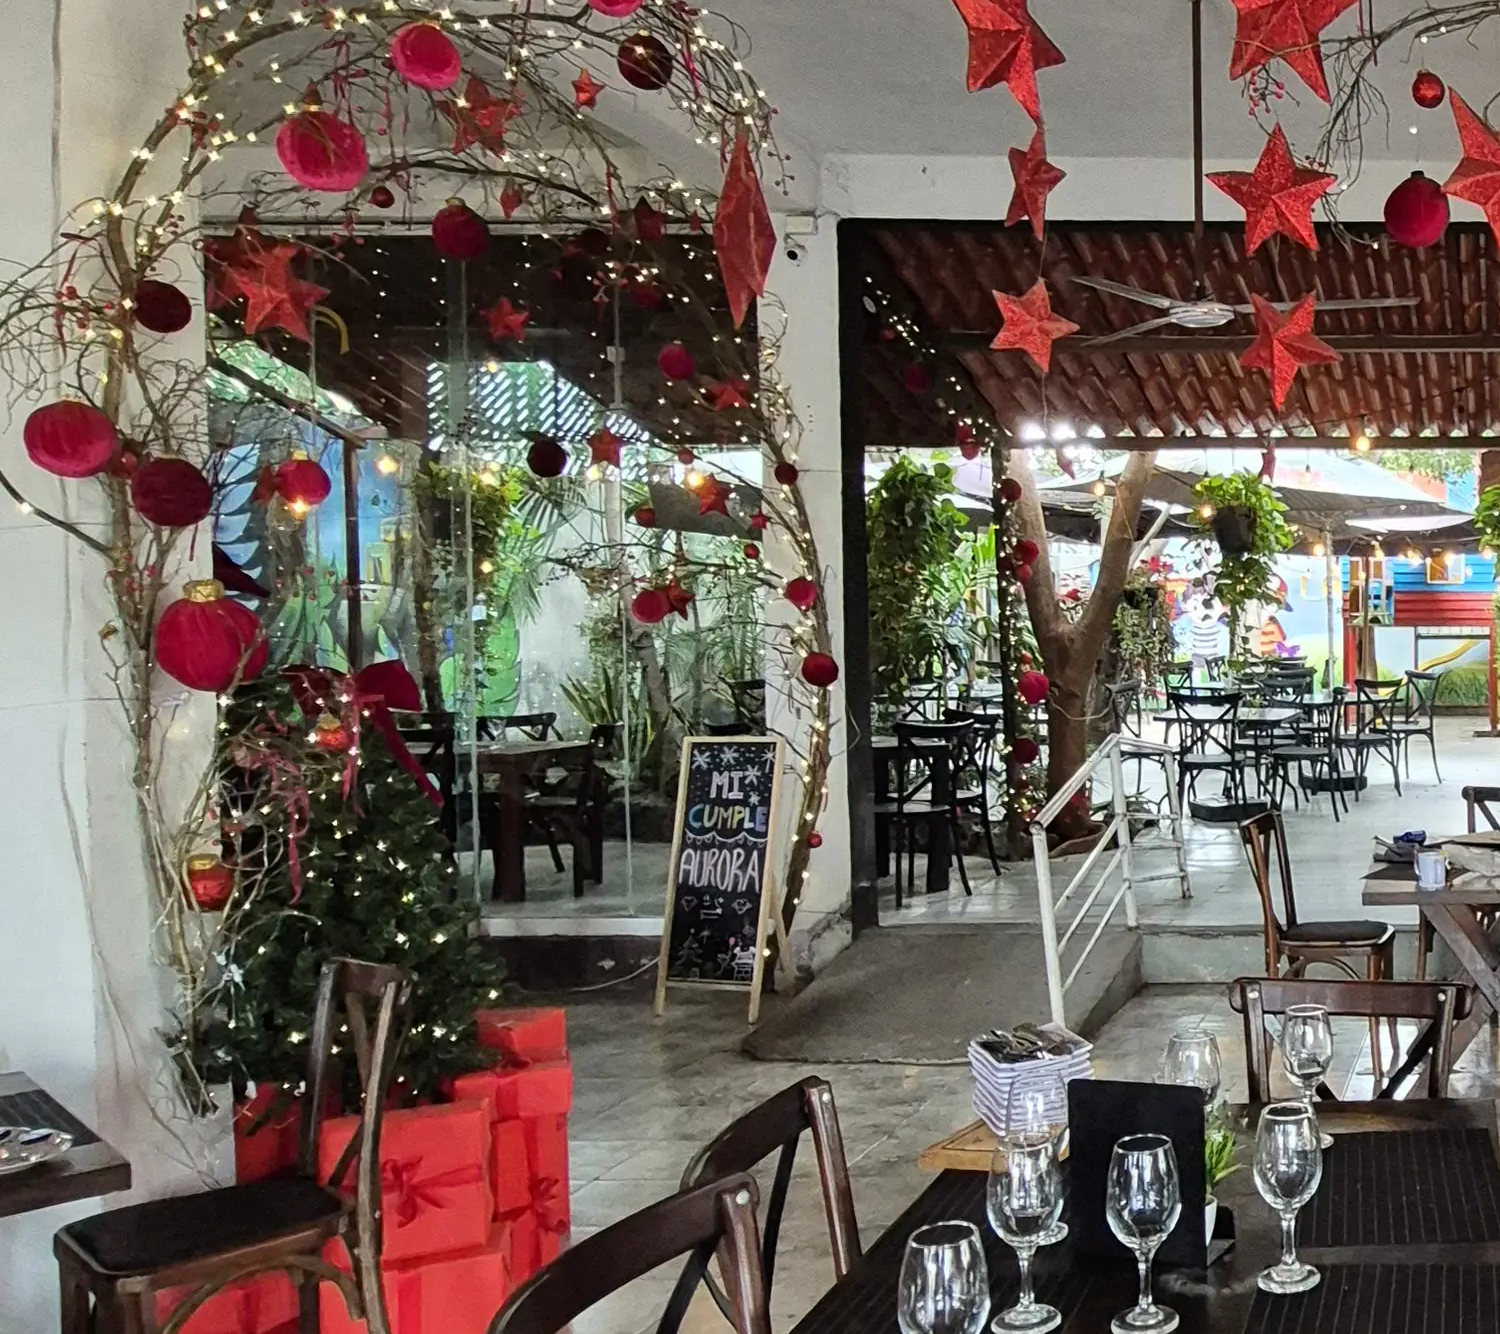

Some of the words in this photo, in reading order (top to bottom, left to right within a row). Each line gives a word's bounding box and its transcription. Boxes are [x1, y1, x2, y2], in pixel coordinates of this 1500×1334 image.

[709, 770, 745, 799] MI
[688, 803, 768, 832] CUMPLE
[678, 847, 760, 894] AURORA
